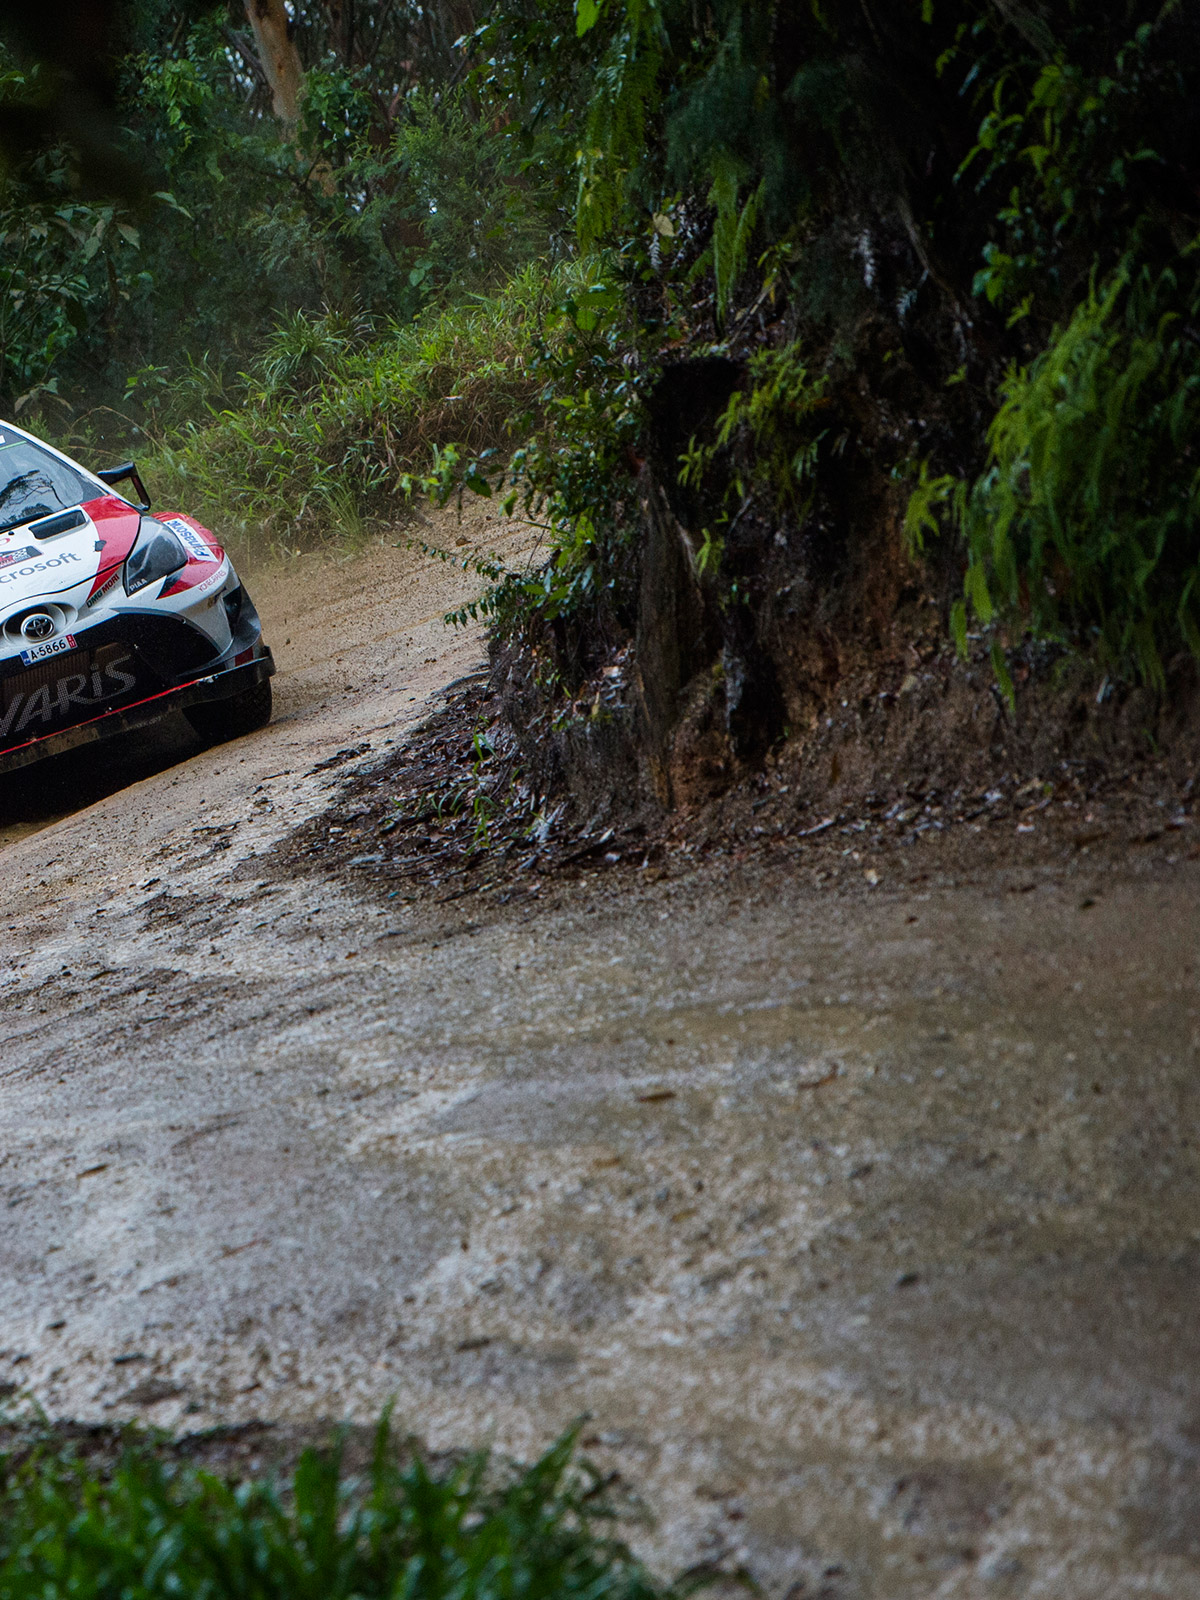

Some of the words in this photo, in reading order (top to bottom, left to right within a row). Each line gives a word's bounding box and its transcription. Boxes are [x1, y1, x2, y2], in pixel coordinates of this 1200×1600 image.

[166, 520, 211, 558] Panasonic
[101, 573, 120, 594] MORI
[129, 578, 148, 592] PIAA
